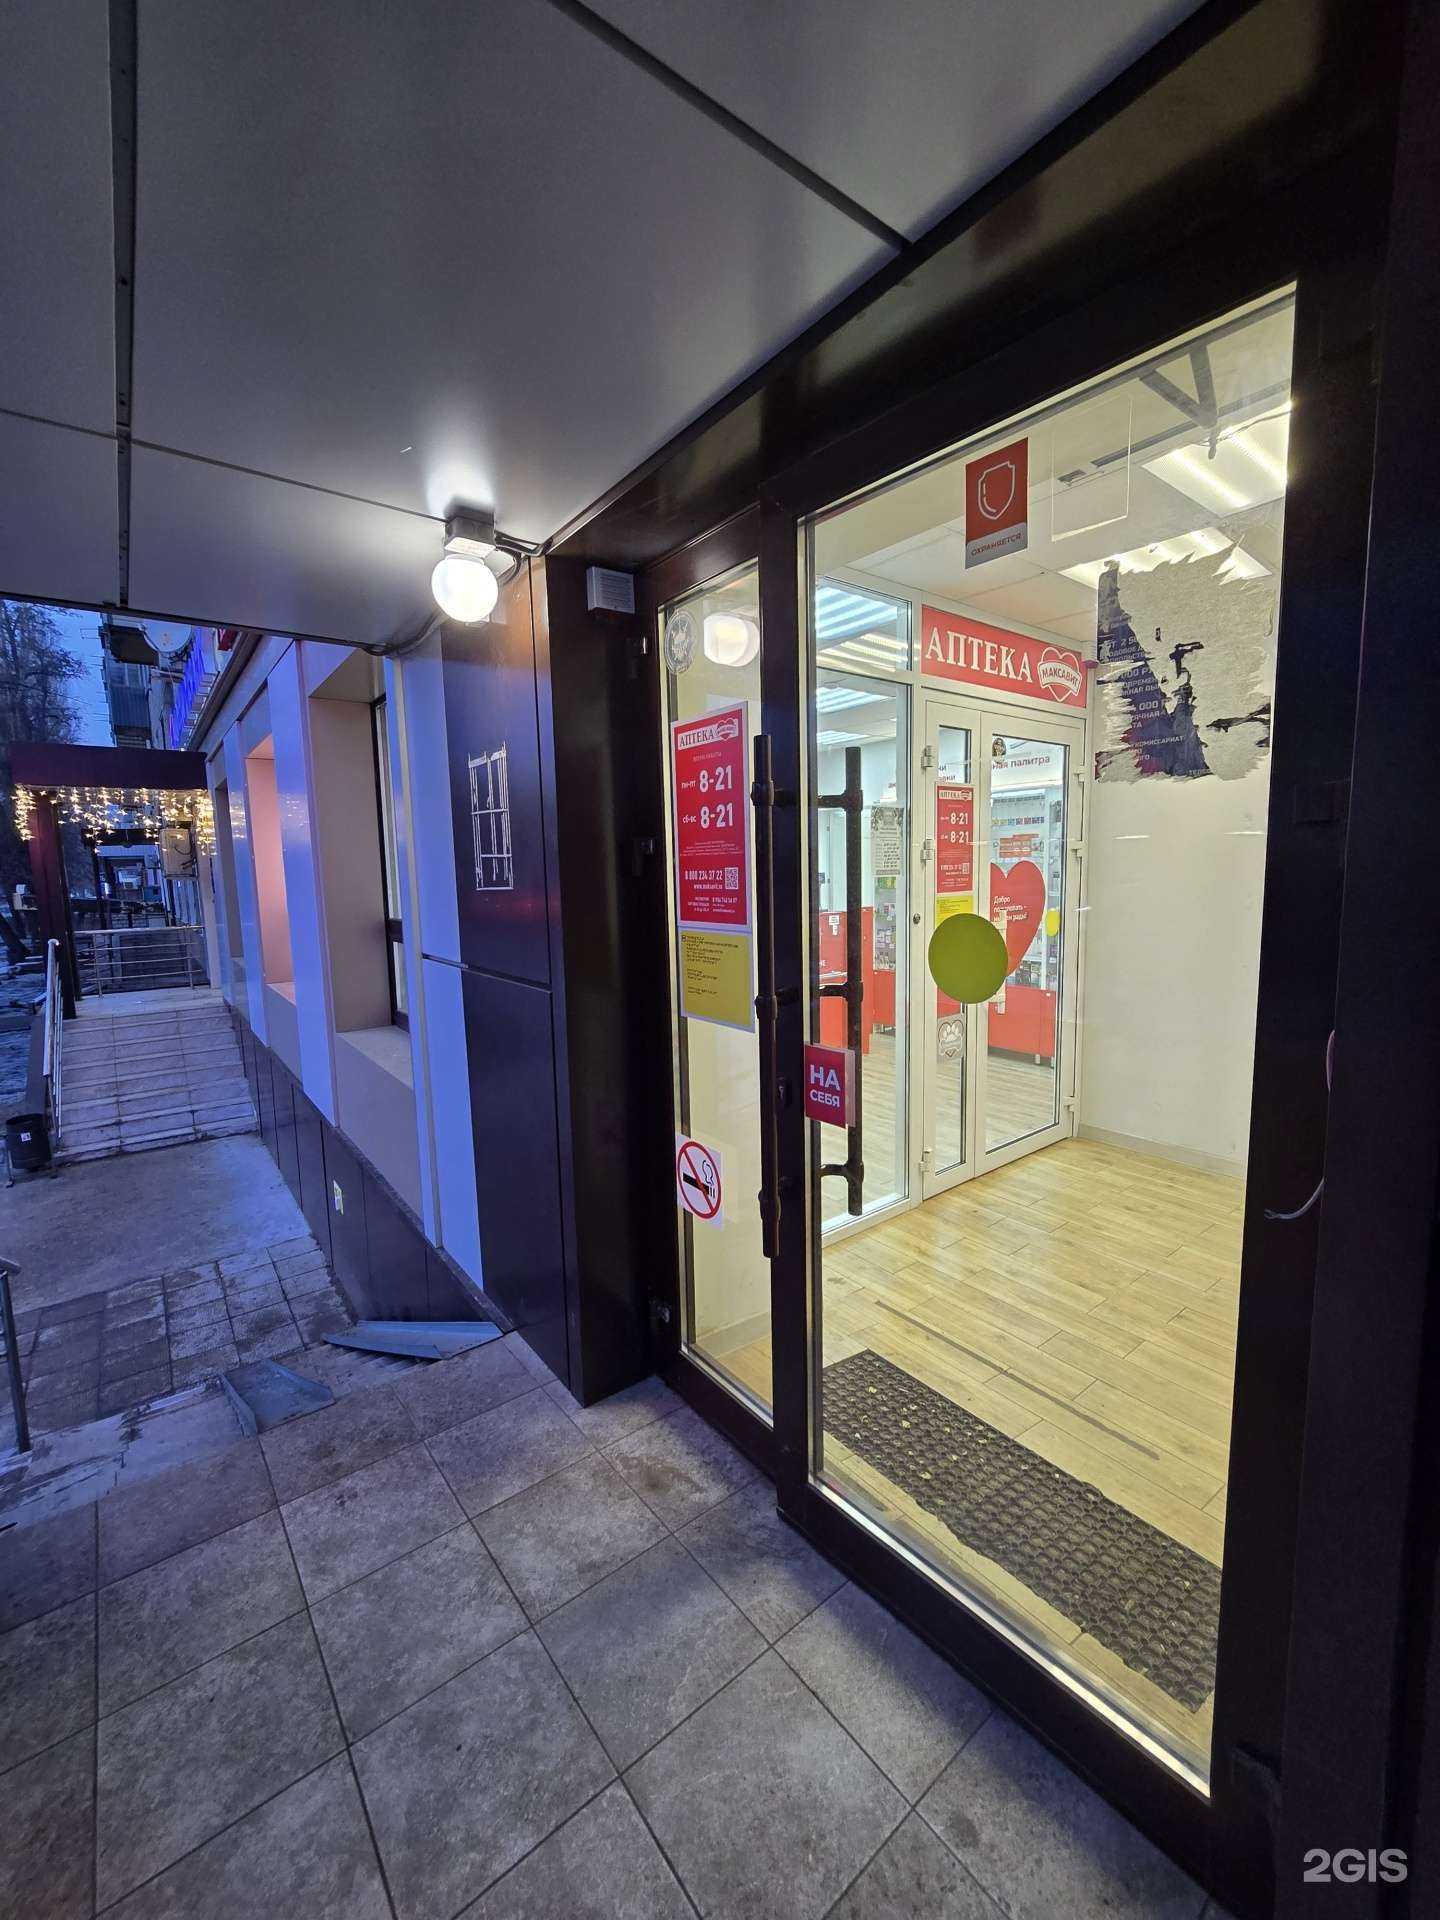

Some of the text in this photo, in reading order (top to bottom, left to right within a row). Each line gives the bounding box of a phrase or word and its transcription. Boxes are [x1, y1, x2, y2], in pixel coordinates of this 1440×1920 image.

[971, 532, 1022, 556] ОХРАНЯЕТСЯ
[925, 627, 1033, 683] АПТЕКА
[1041, 667, 1078, 687] МАКСАВИТ
[679, 728, 715, 748] АПТЕКА
[1011, 755, 1050, 768] палитра
[699, 765, 733, 792] 8-21
[700, 802, 734, 829] 8-21
[950, 812, 968, 825] 8-21
[950, 831, 969, 844] 8-21
[993, 896, 1011, 905] Добро
[810, 1064, 840, 1091] НА
[810, 1089, 840, 1108] СЕБЯ
